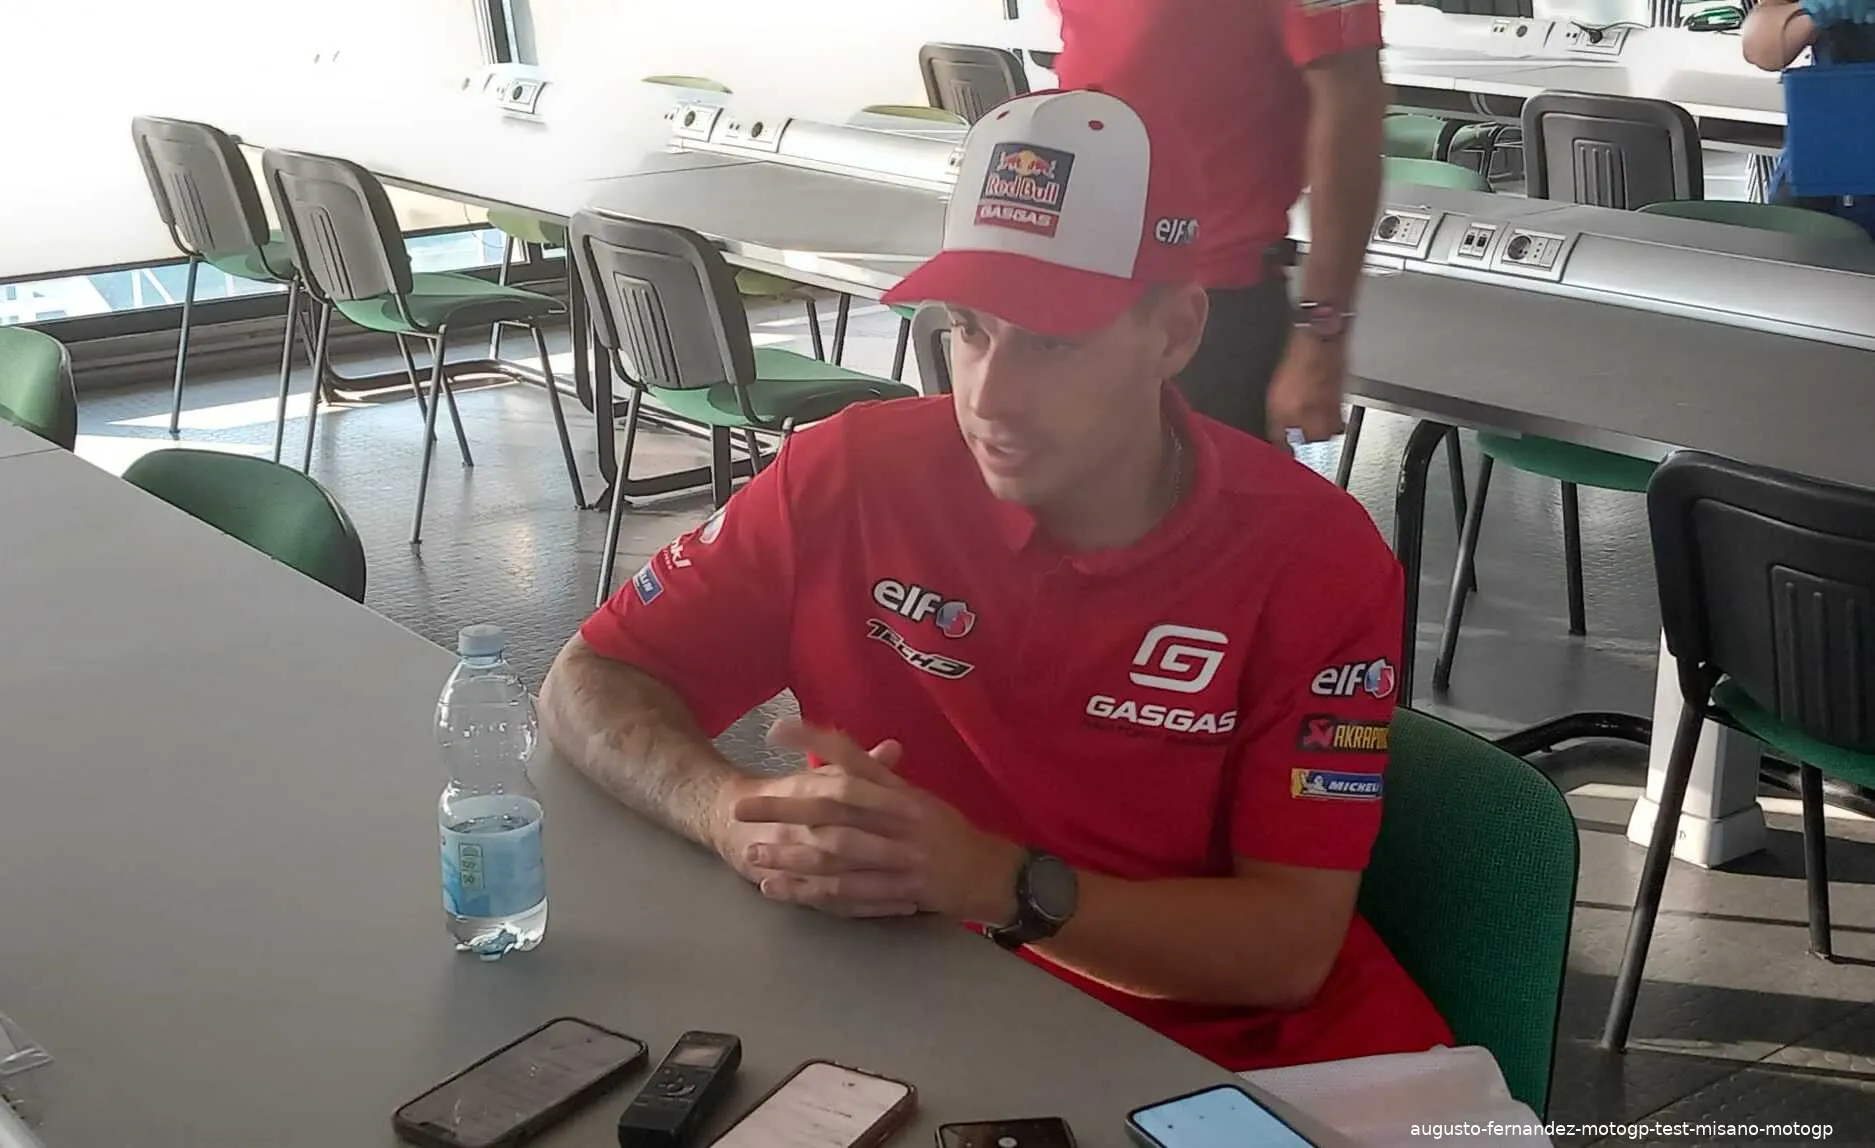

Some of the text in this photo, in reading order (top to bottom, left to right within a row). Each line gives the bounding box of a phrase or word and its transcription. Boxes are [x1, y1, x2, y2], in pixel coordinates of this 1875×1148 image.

[984, 172, 1060, 204] Red Bull
[979, 205, 1052, 226] GASGAS
[1155, 218, 1187, 244] elf
[873, 579, 941, 622] elf
[1311, 663, 1367, 696] elf
[1086, 694, 1238, 734] GASGAS
